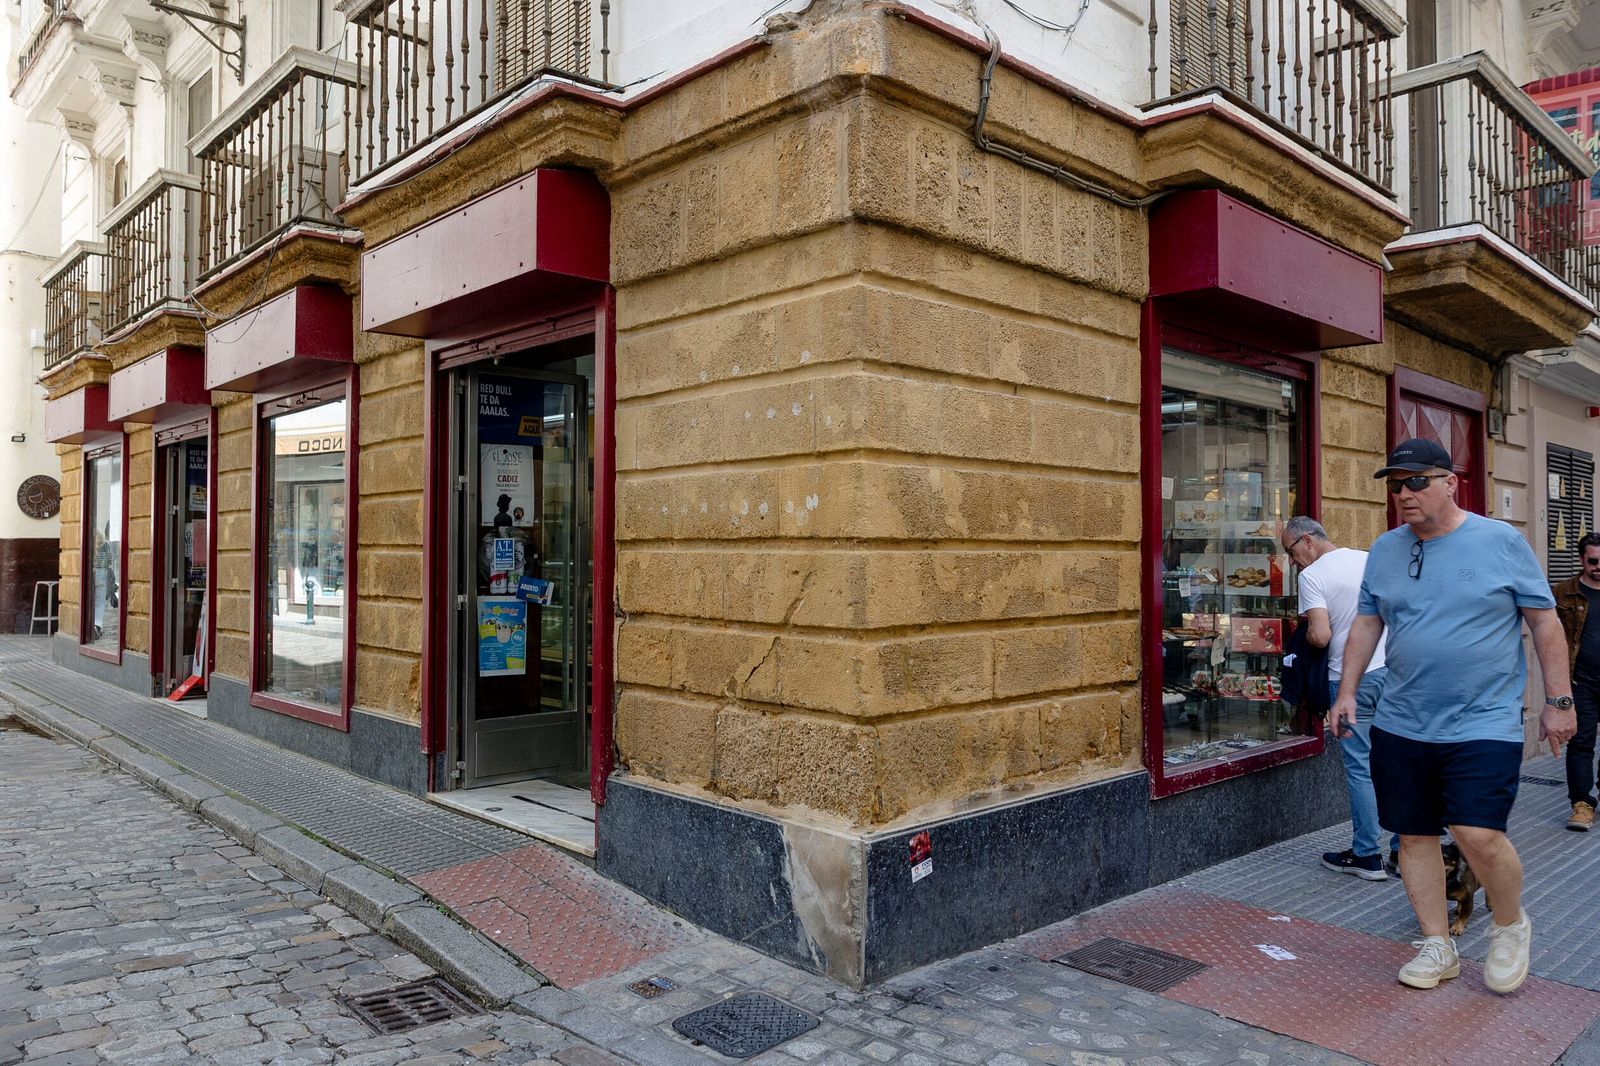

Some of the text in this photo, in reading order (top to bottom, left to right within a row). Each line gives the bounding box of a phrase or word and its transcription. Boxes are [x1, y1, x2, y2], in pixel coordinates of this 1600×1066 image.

[480, 383, 512, 396] RED BULL
[480, 394, 500, 405] TE DA
